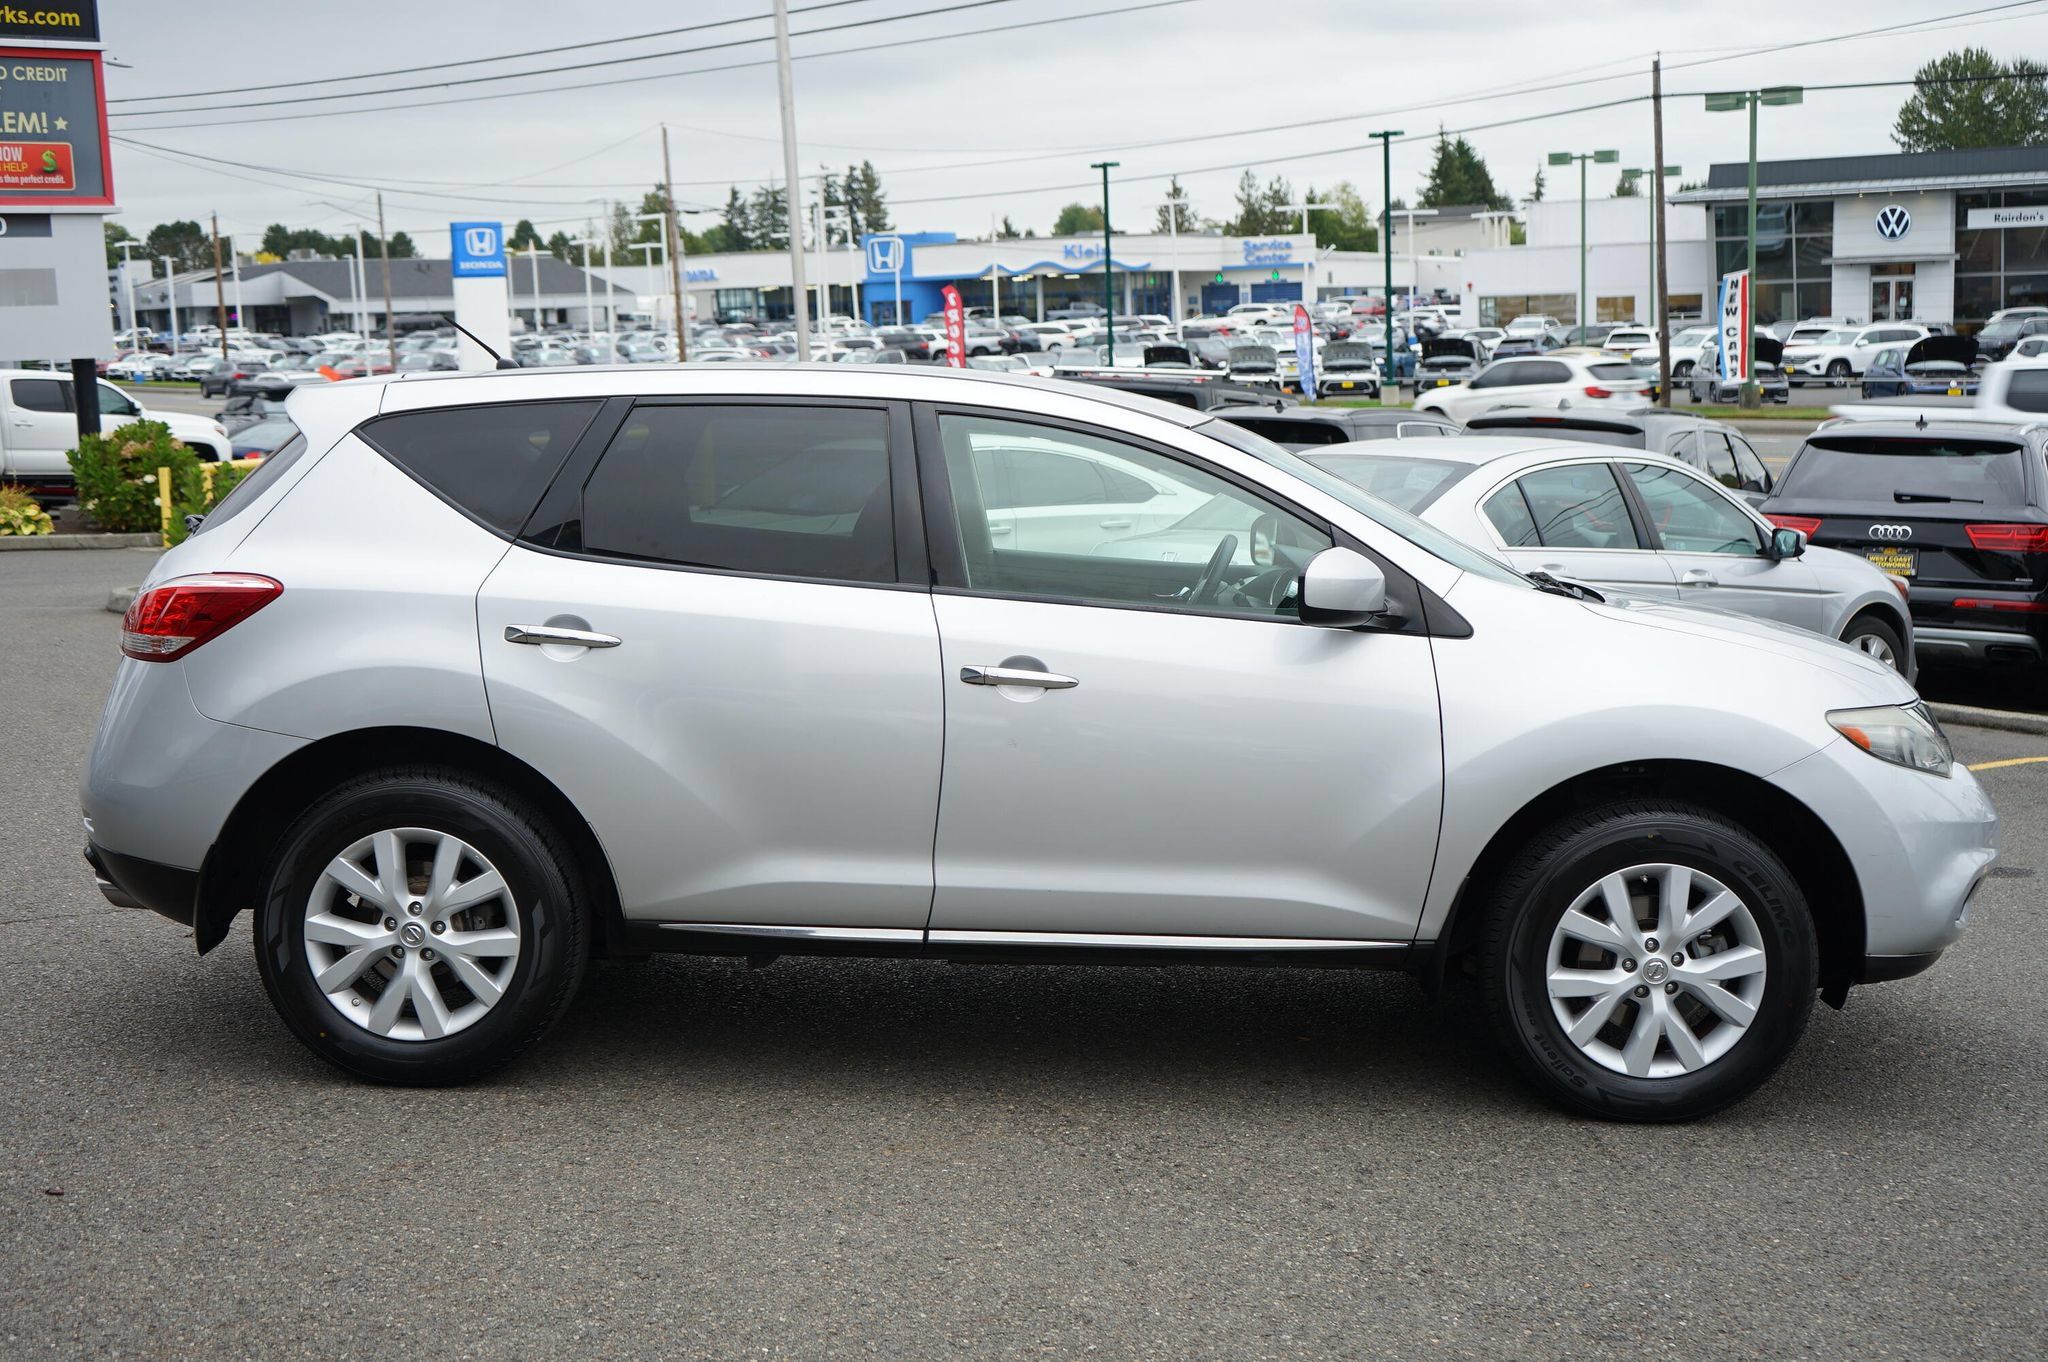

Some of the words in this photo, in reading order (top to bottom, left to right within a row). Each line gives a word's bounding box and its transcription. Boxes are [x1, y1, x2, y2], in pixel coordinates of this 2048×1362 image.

[12, 66, 68, 82] CREDIT
[0, 112, 49, 134] EM!
[4, 162, 28, 172] HELP
[4, 174, 19, 184] than
[20, 175, 44, 185] perfect
[1994, 211, 2044, 224] Rairdon's
[1725, 279, 1739, 317] NEW
[1726, 327, 1739, 378] CARS
